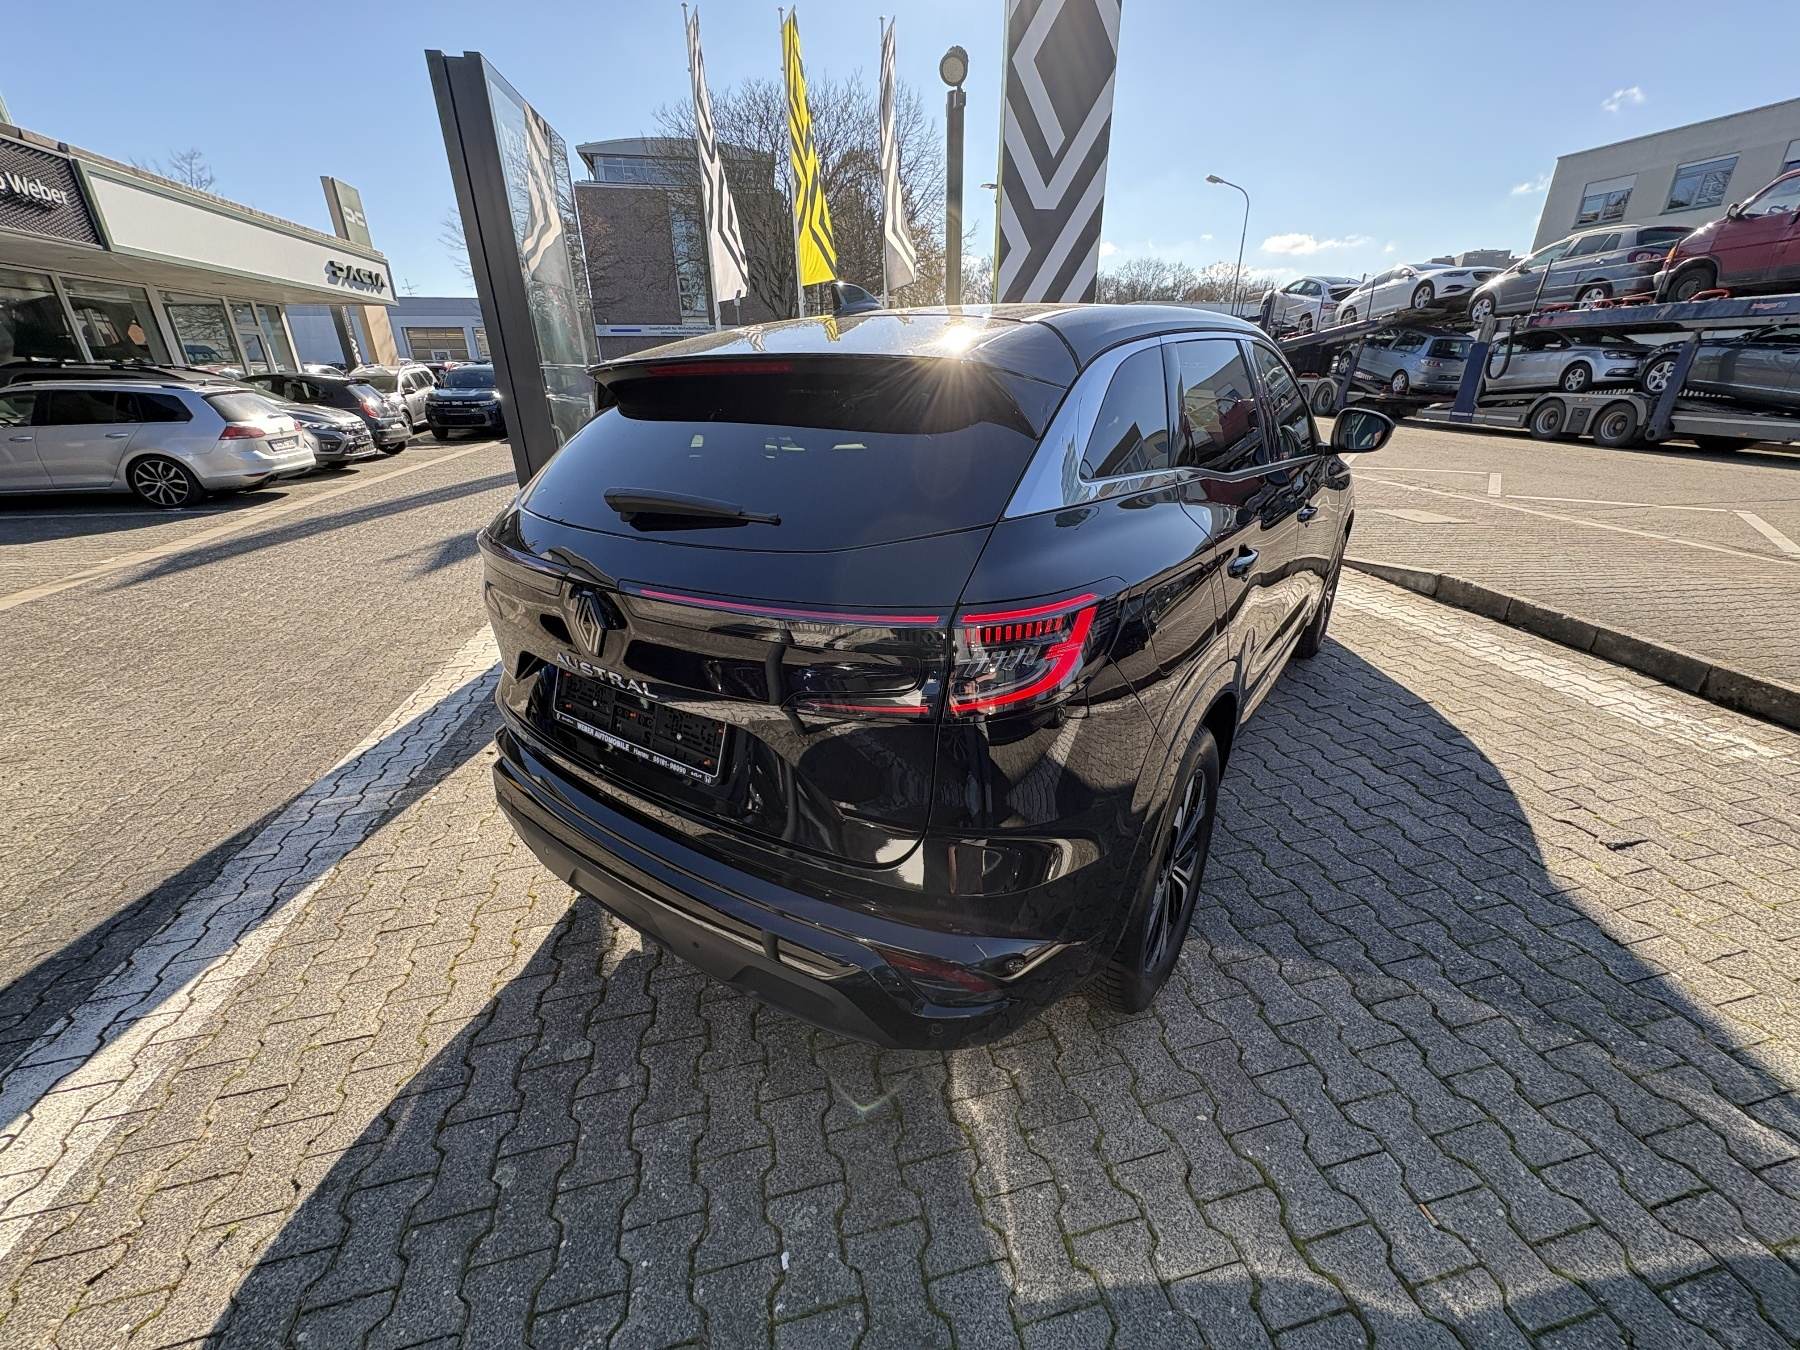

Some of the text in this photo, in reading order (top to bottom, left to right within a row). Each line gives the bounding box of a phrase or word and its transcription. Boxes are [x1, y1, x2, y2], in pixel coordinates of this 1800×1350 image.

[4, 171, 68, 206] Weber
[556, 652, 659, 699] AUSTRAL
[576, 721, 595, 736] WEBER
[594, 731, 630, 753] AUTOMOBILE
